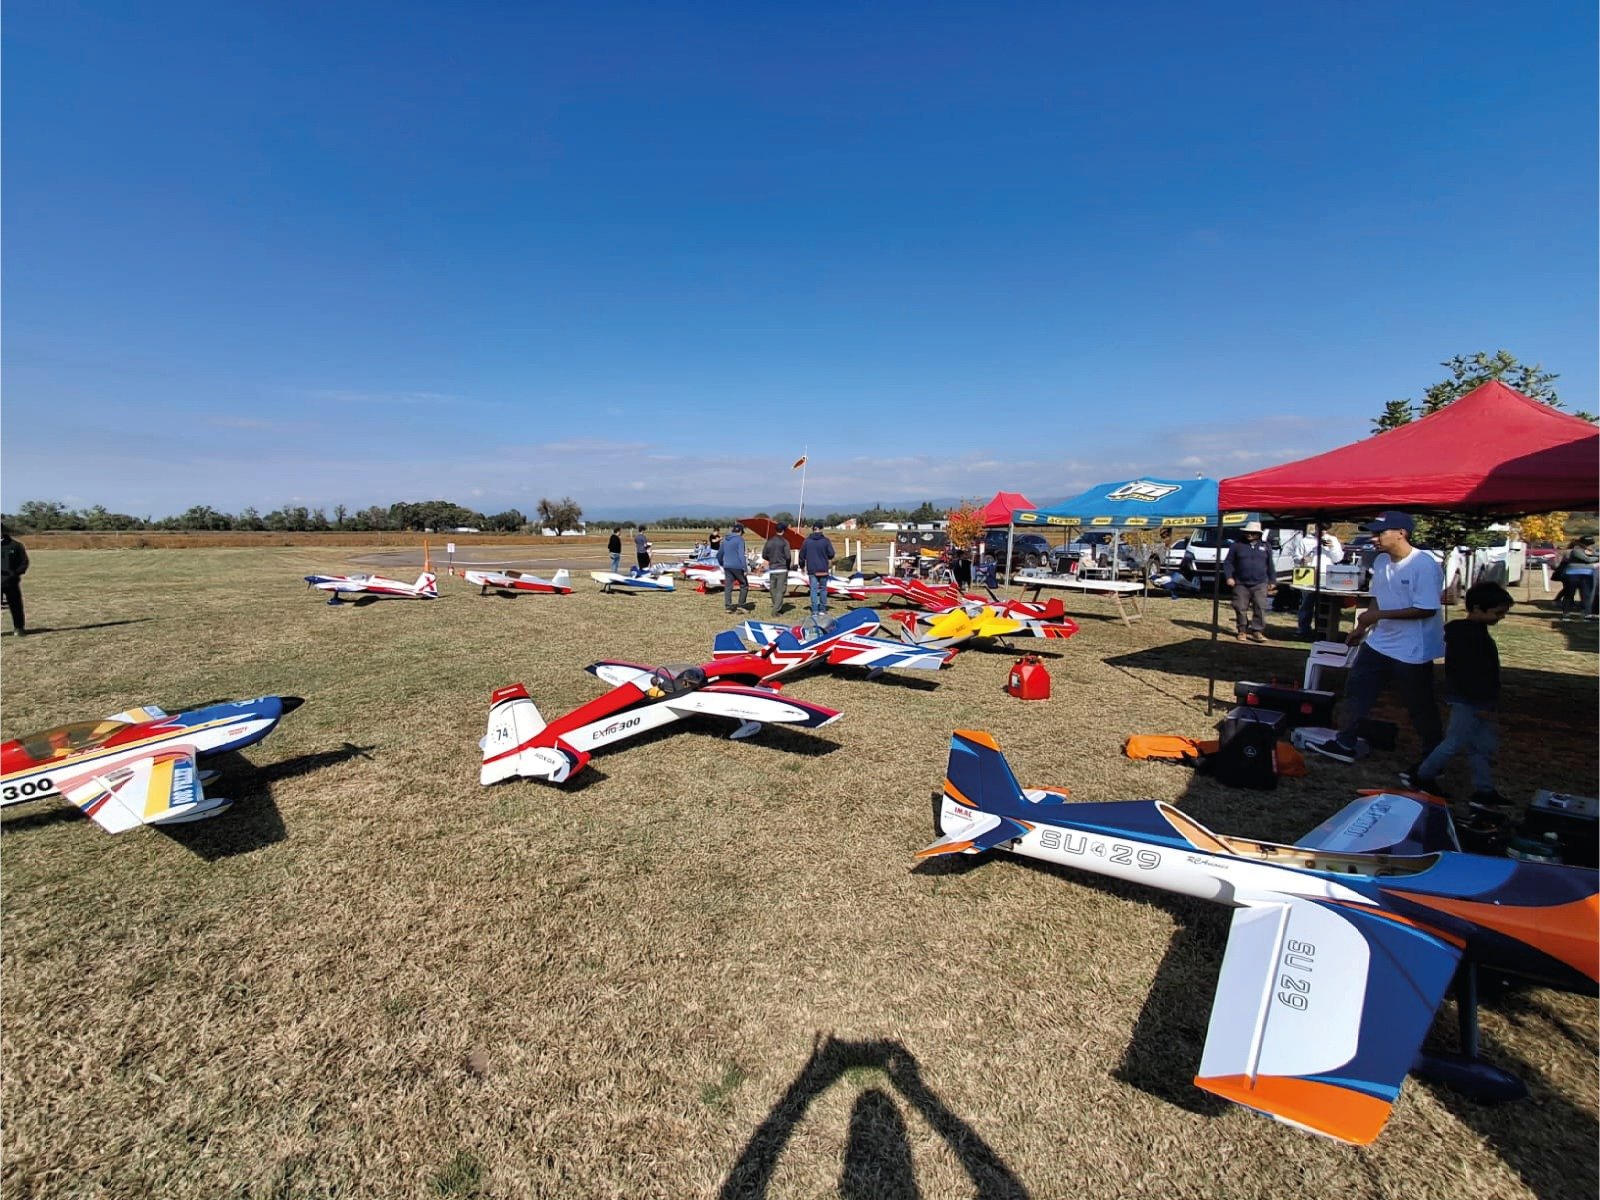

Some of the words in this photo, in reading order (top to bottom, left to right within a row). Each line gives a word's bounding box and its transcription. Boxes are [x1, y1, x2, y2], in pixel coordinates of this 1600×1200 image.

[496, 727, 509, 741] 74
[618, 717, 641, 731] 300
[3, 778, 54, 800] 300
[1040, 829, 1088, 856] SU
[1109, 844, 1162, 870] 29
[1284, 939, 1316, 972] SU
[1277, 974, 1311, 1011] 29
